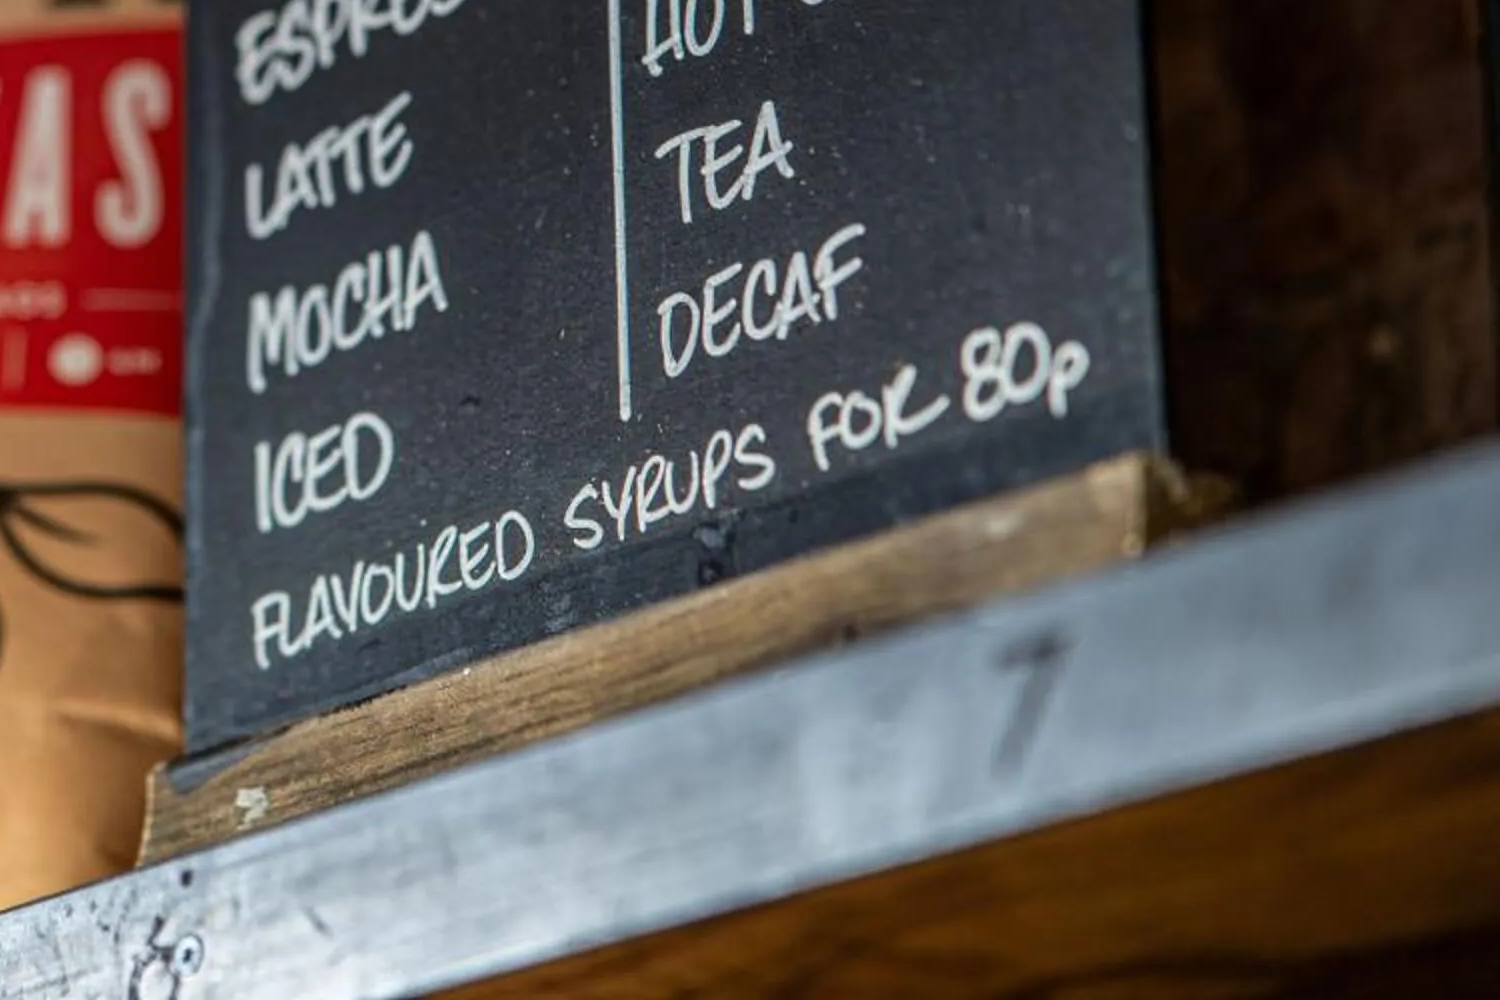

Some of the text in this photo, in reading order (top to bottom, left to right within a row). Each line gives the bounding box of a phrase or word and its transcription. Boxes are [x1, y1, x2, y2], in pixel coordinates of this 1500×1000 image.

[243, 91, 414, 240] LATTE
[654, 100, 795, 224] TEA
[247, 229, 448, 394] MOCHA
[656, 223, 867, 379] DECAF
[251, 321, 1090, 672] FLAVOURED SYRUPS FOR 80p
[254, 411, 394, 534] ICED
